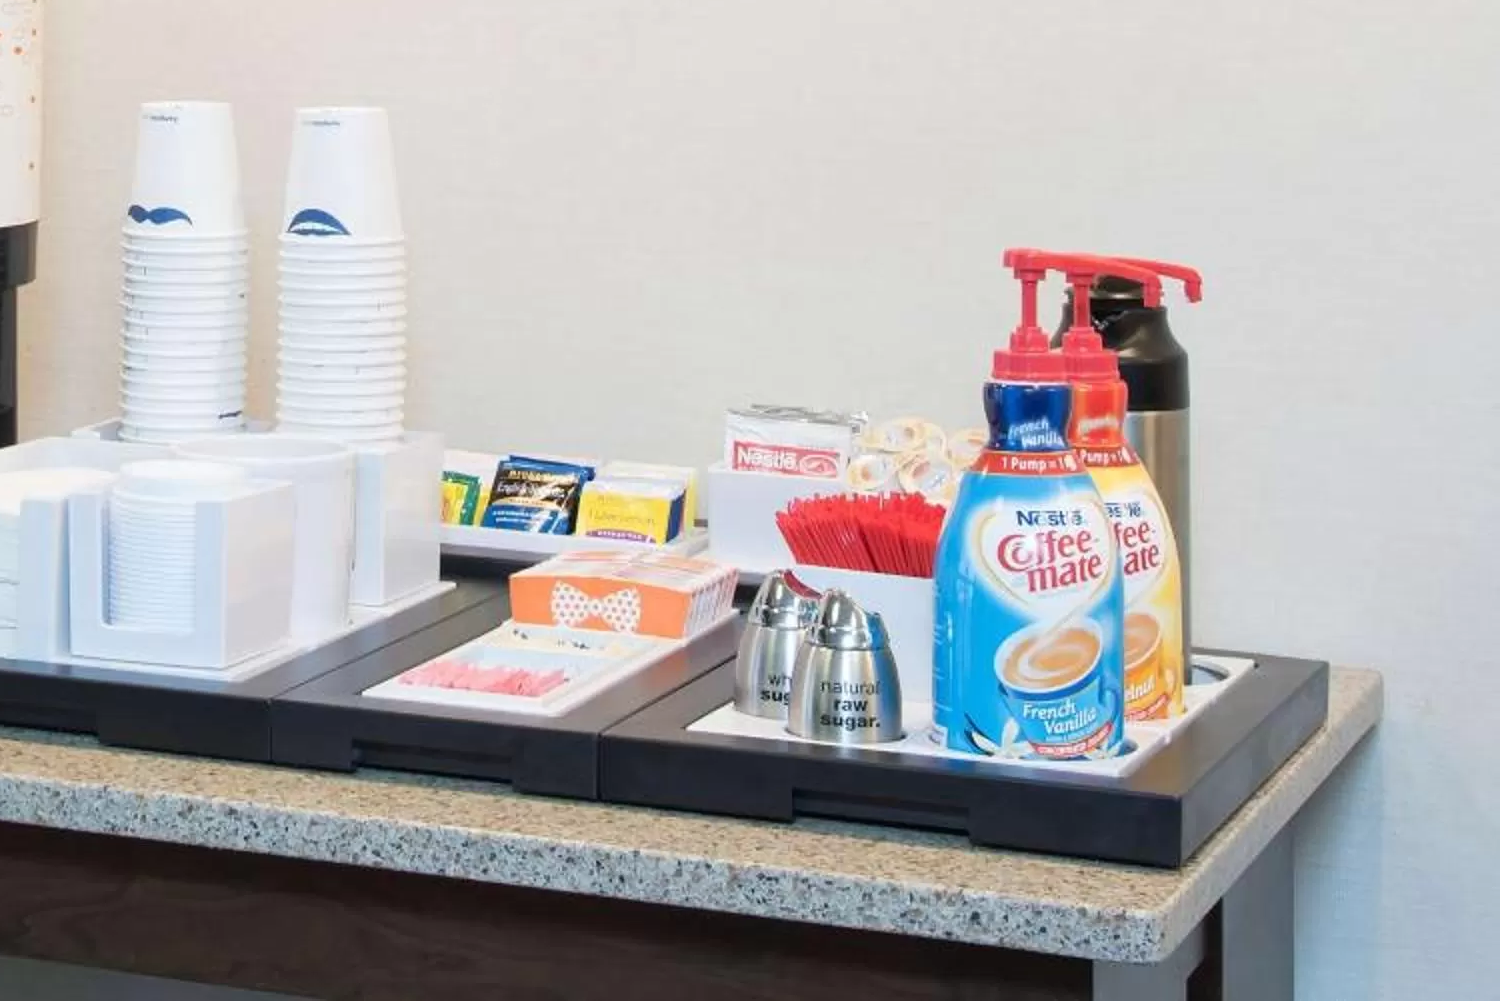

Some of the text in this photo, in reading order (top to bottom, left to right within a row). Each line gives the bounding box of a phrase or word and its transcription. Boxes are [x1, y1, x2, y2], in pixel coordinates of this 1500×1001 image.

[1011, 457, 1047, 473] Pump
[1080, 450, 1109, 465] Pump
[1124, 544, 1159, 576] ate
[1027, 554, 1103, 593] mate
[820, 680, 881, 696] natural
[834, 700, 868, 712] raw
[1023, 699, 1076, 719] French
[820, 714, 881, 731] sugar.
[1044, 708, 1097, 735] Vanilla
